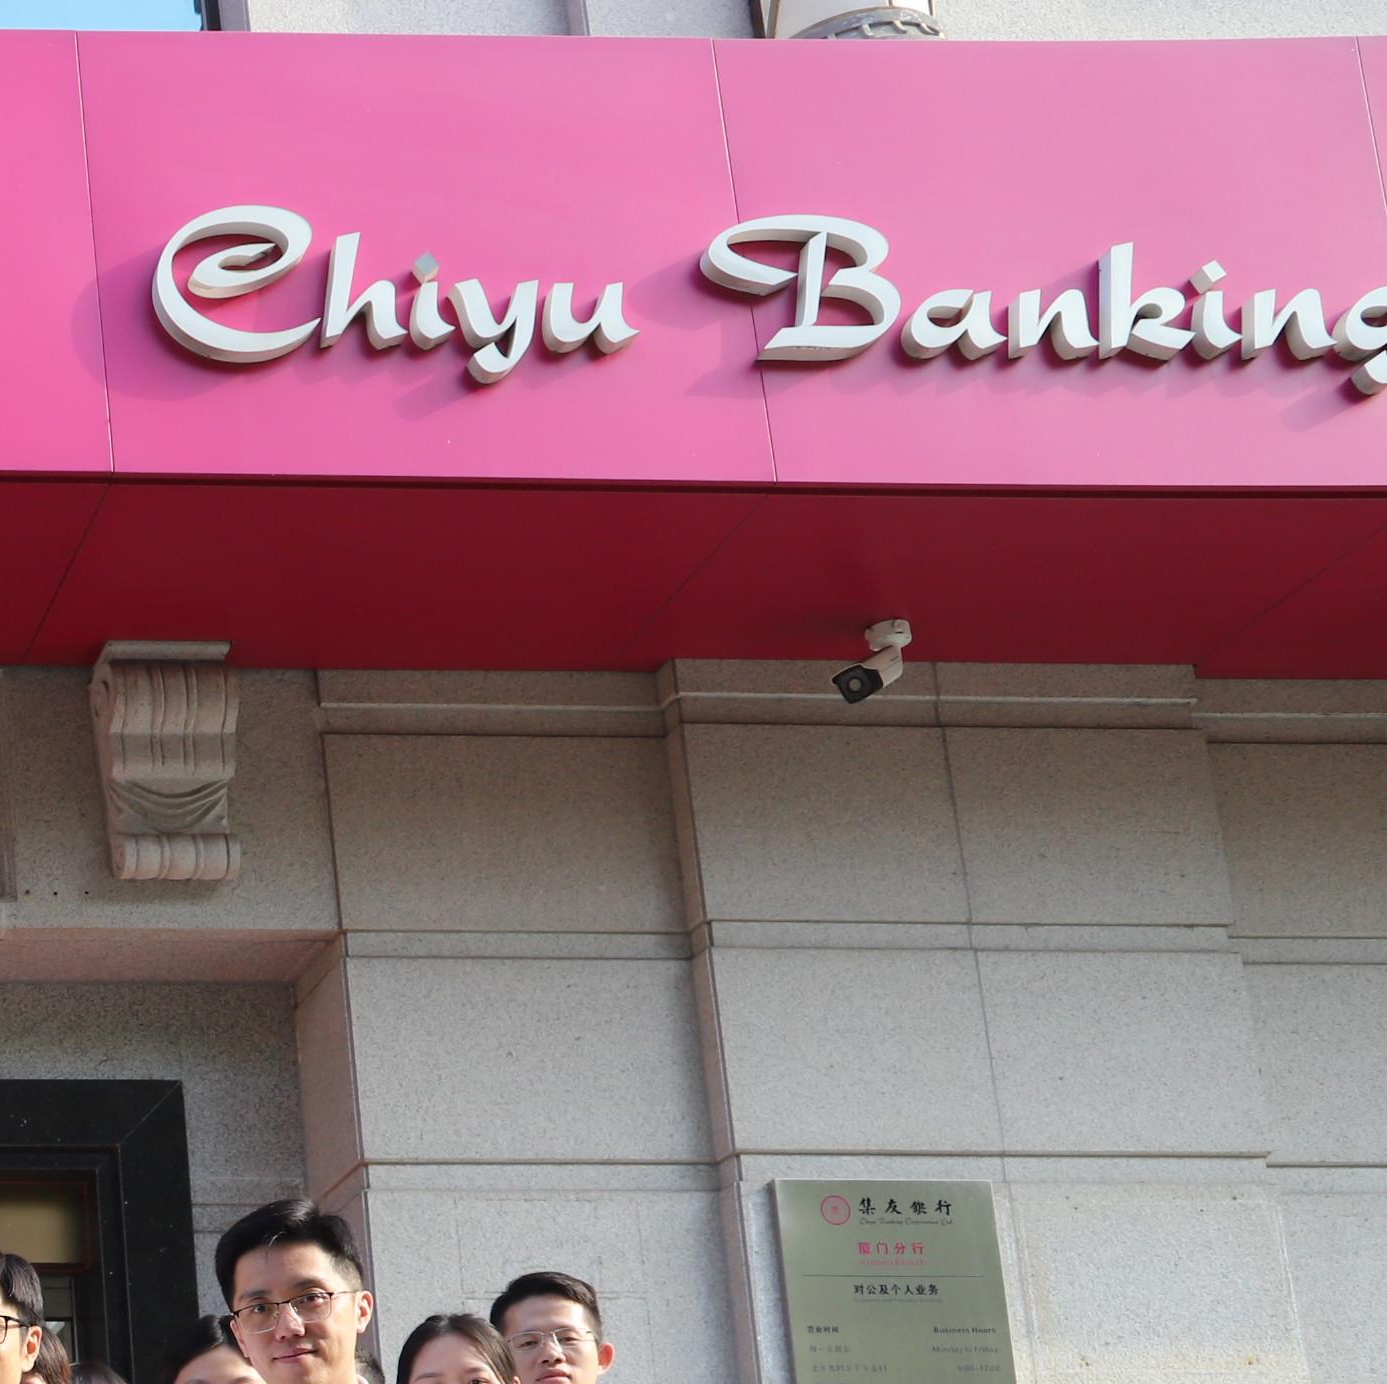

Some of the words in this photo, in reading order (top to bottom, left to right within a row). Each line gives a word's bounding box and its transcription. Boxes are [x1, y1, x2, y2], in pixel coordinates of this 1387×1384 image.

[152, 204, 641, 384] Chiyu
[853, 1283, 940, 1296] 对公及个人业务
